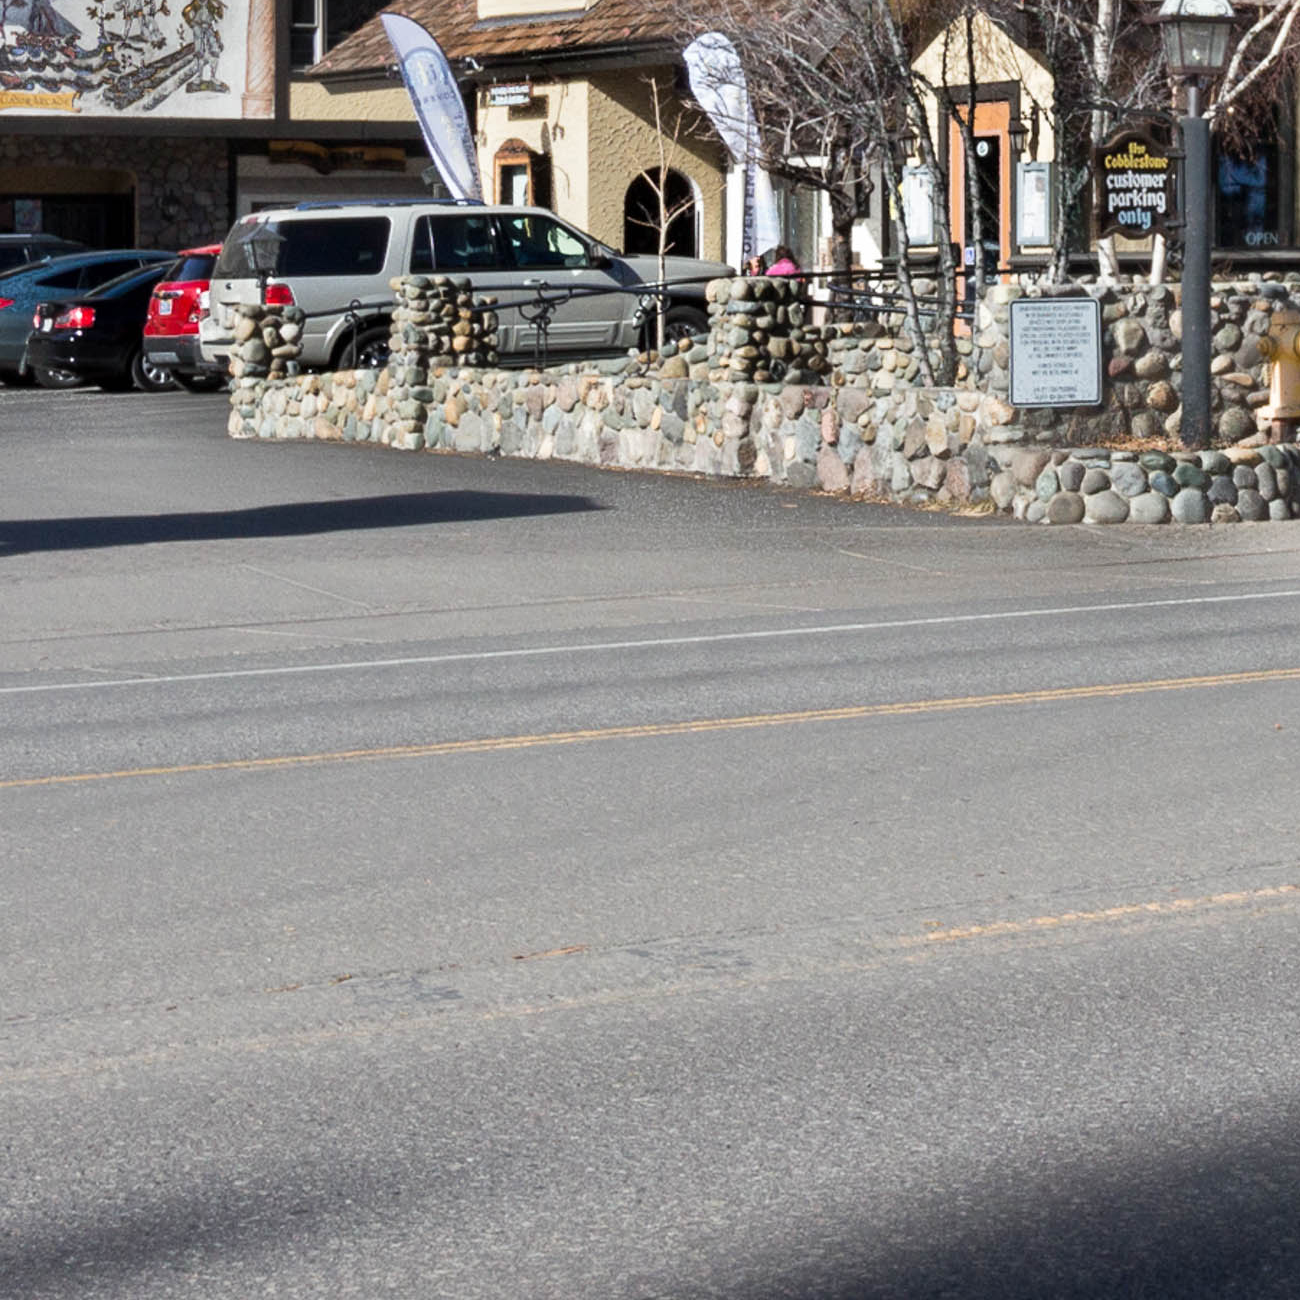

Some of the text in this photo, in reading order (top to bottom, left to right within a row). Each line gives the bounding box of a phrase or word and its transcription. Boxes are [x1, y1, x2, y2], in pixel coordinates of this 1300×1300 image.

[1105, 153, 1168, 169] Cobblestone
[1106, 169, 1167, 189] customer
[1108, 188, 1166, 214] parking
[1118, 207, 1151, 230] only
[1245, 231, 1279, 246] OPEN
